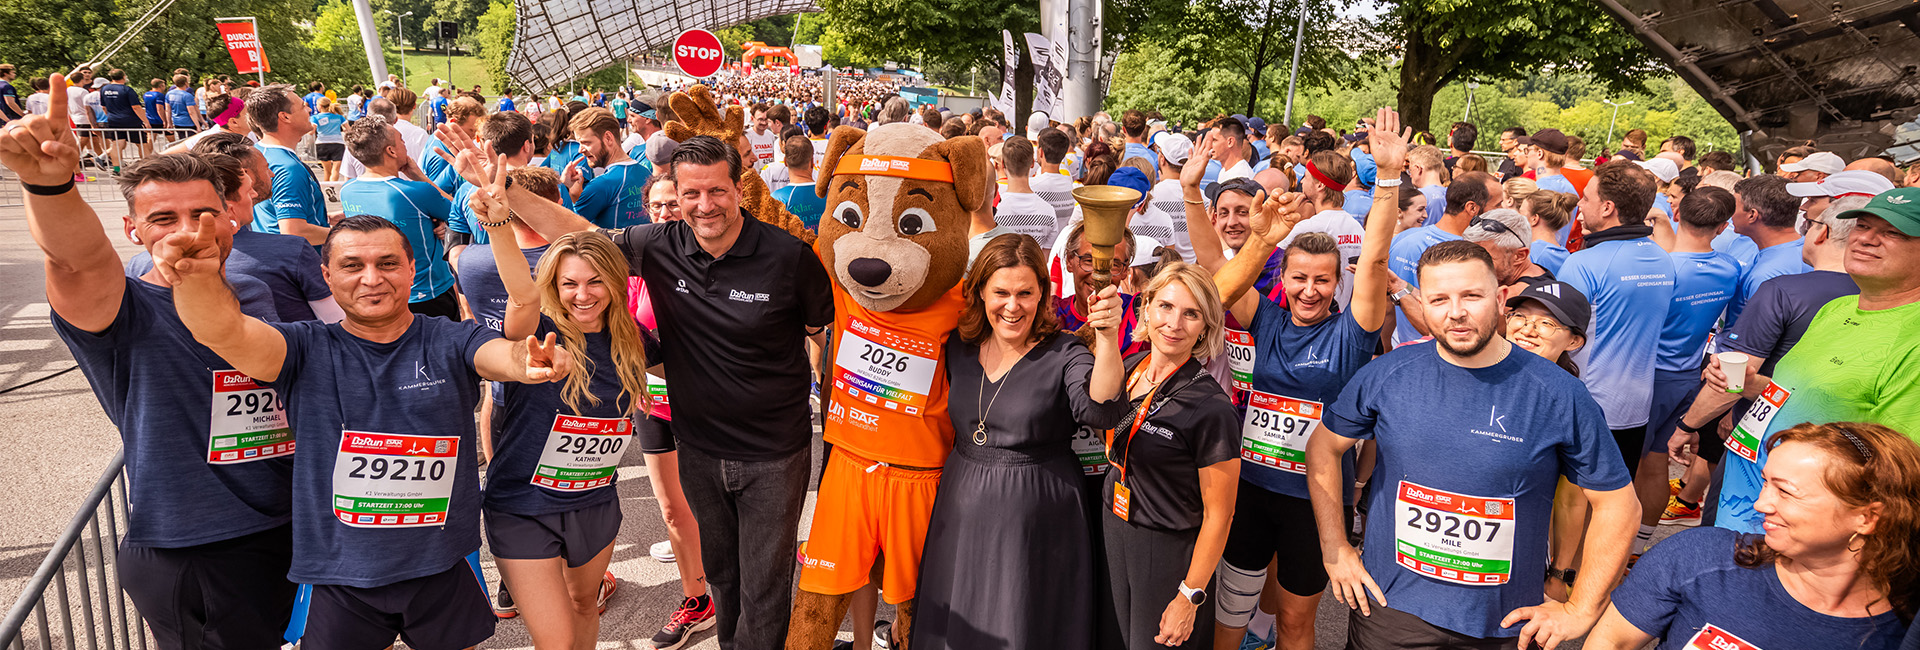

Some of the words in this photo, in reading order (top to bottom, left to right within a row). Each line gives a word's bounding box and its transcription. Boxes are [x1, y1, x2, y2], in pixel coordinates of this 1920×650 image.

[677, 45, 720, 60] STOP
[860, 344, 910, 372] 2026
[869, 365, 891, 377] BUDDY
[224, 375, 251, 384] B2Run
[843, 373, 873, 390] GEMEINSAM
[872, 385, 886, 395] FÜR
[885, 389, 914, 401] VIELFALT
[253, 415, 281, 423] MICHAEL
[850, 407, 879, 426] DAK
[1251, 409, 1311, 436] 29197
[241, 434, 269, 443] STARTZEIT
[351, 436, 383, 447] B2Run
[1264, 431, 1285, 441] SAMIRA
[556, 435, 623, 454] 29200
[349, 456, 445, 482] 29210
[1406, 487, 1434, 502] B2Run
[358, 501, 393, 509] STARTZEIT
[1408, 507, 1500, 542] 29207
[1441, 538, 1462, 548] MILE
[1419, 551, 1452, 563] STARTZEIT
[1452, 558, 1471, 567] 17:00
